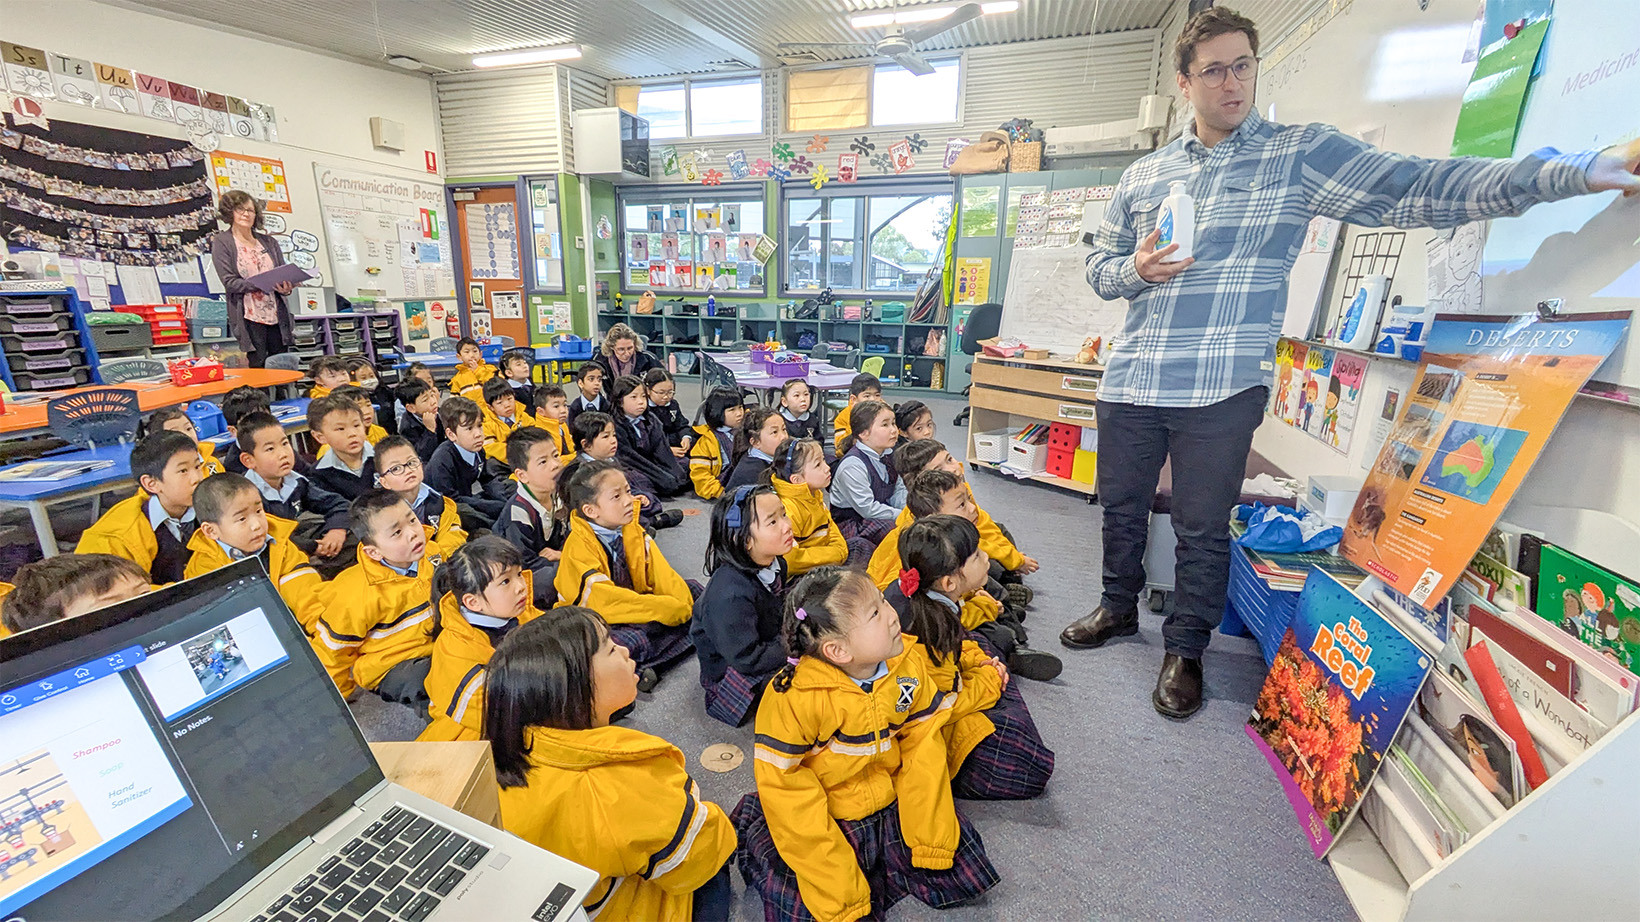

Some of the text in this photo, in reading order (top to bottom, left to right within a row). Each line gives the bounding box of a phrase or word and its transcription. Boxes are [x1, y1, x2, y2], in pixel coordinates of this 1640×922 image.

[12, 46, 36, 66] Ss
[57, 55, 83, 75] Tt
[100, 65, 129, 86] Uu
[1561, 48, 1640, 97] Medicine
[139, 75, 162, 93] Vv
[321, 170, 409, 197] Communication
[413, 184, 443, 203] Board
[1465, 328, 1580, 348] DESERTS
[1336, 359, 1361, 384] Spring
[1371, 561, 1399, 583] SCHOLASTIC
[1347, 615, 1368, 642] The
[1578, 626, 1603, 646] THE
[149, 640, 167, 651] slide
[1333, 622, 1373, 667] Coral
[1311, 623, 1376, 701] Reef
[78, 676, 95, 684] Home
[47, 686, 69, 698] Control
[4, 703, 22, 712] Timer
[1508, 677, 1521, 693] of
[1534, 687, 1593, 750] Wombat
[173, 715, 213, 739] No Notes.
[72, 738, 122, 760] Shampoo
[99, 761, 125, 778] Soap
[108, 782, 135, 799] Hand
[111, 786, 153, 809] Sanitizer
[335, 892, 345, 902] P
[535, 901, 554, 921] intel
